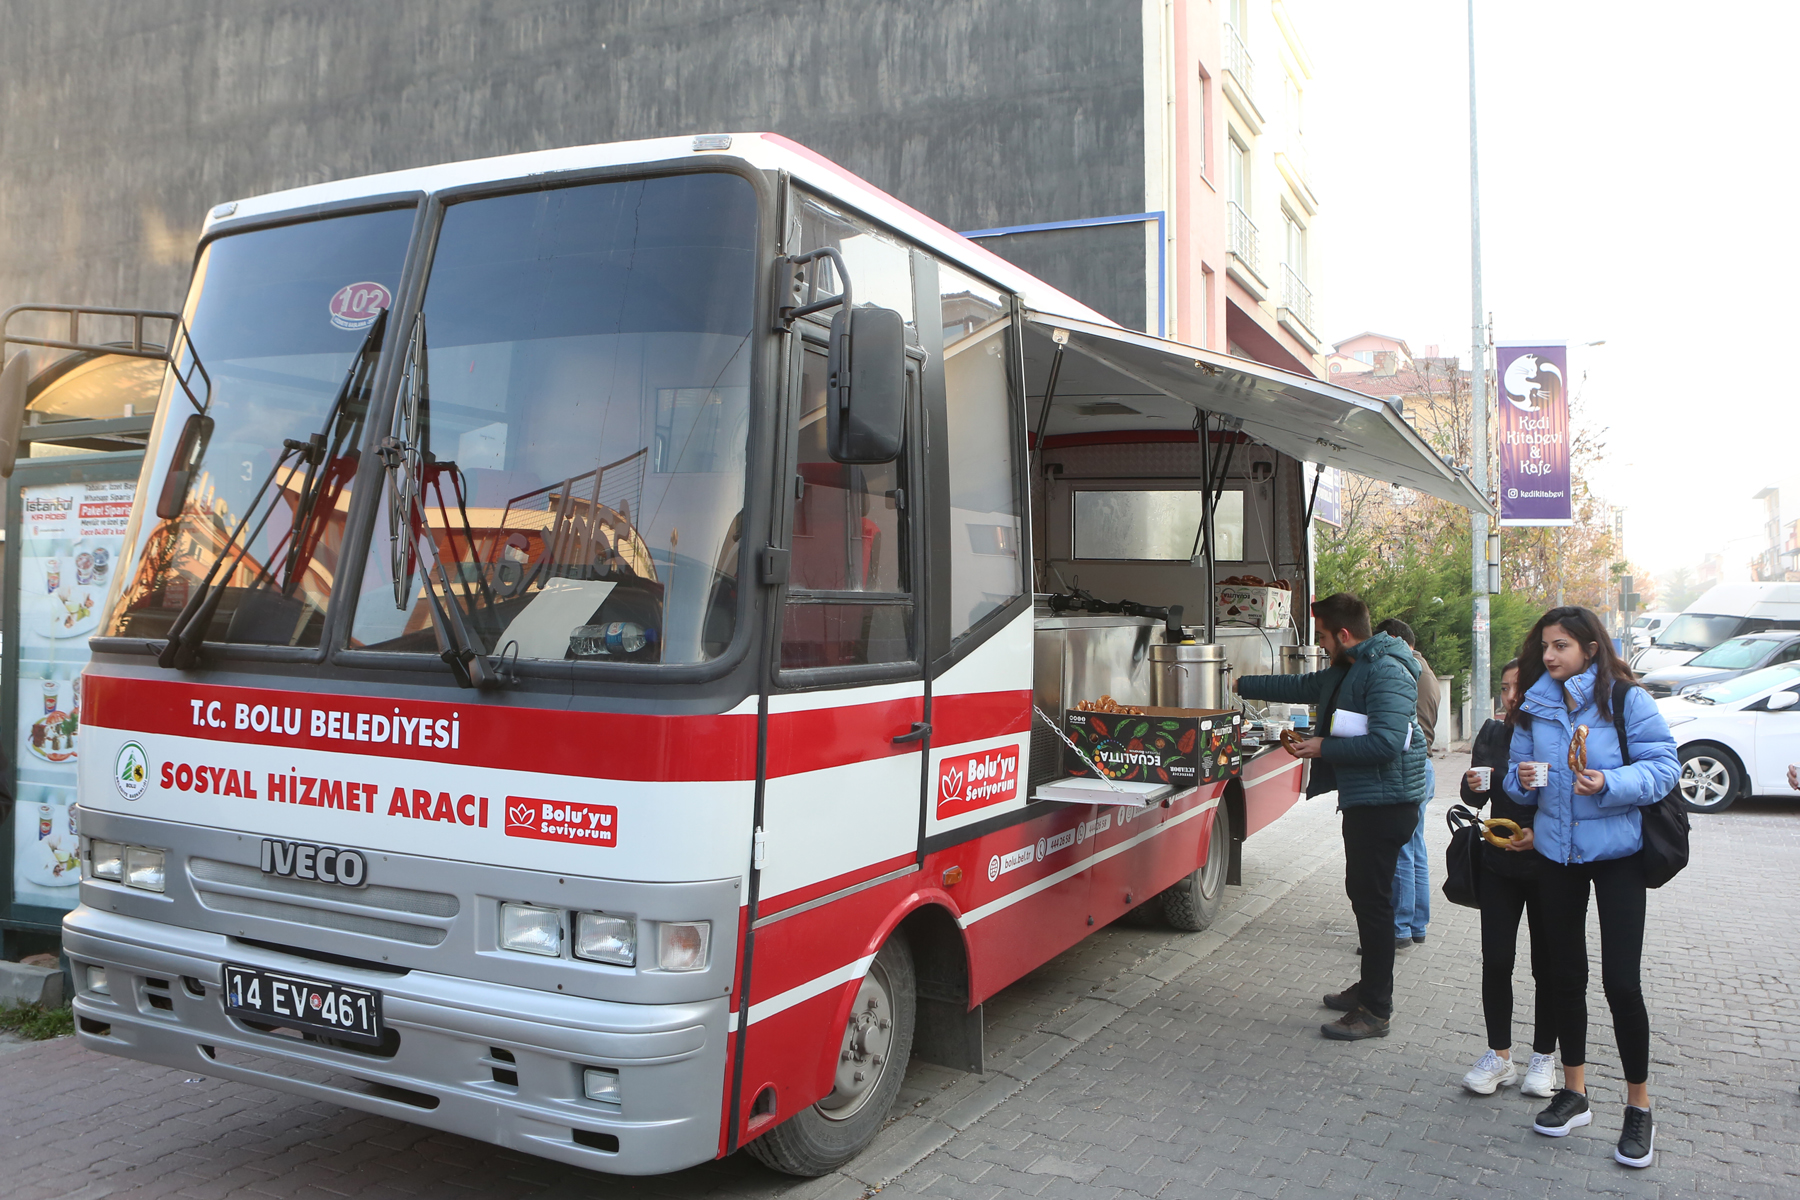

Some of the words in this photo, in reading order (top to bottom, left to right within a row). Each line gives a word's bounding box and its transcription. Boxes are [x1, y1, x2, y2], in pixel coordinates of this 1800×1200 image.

[339, 288, 383, 314] 102
[1519, 415, 1550, 431] Kedi
[1506, 430, 1563, 446] Kitabevi
[1529, 445, 1541, 459] &
[1520, 460, 1552, 477] Kafe
[1520, 489, 1564, 499] kedikitabevi
[82, 505, 104, 517] Paket
[191, 699, 227, 729] T.C.
[234, 702, 302, 736] BOLU
[310, 707, 460, 749] BELEDİYESİ
[1100, 750, 1161, 766] ECUALITTA
[160, 761, 258, 799] SOSYAL
[268, 766, 379, 813] HİZMET
[387, 786, 489, 828] ARACI
[965, 778, 1015, 802] Seviyorum
[540, 821, 612, 841] Seviyorum
[261, 838, 368, 888] IVECO
[1005, 850, 1032, 869] bolu.bel.tr
[233, 974, 262, 1010] 14
[272, 981, 308, 1018] EV
[321, 991, 368, 1030] 461
